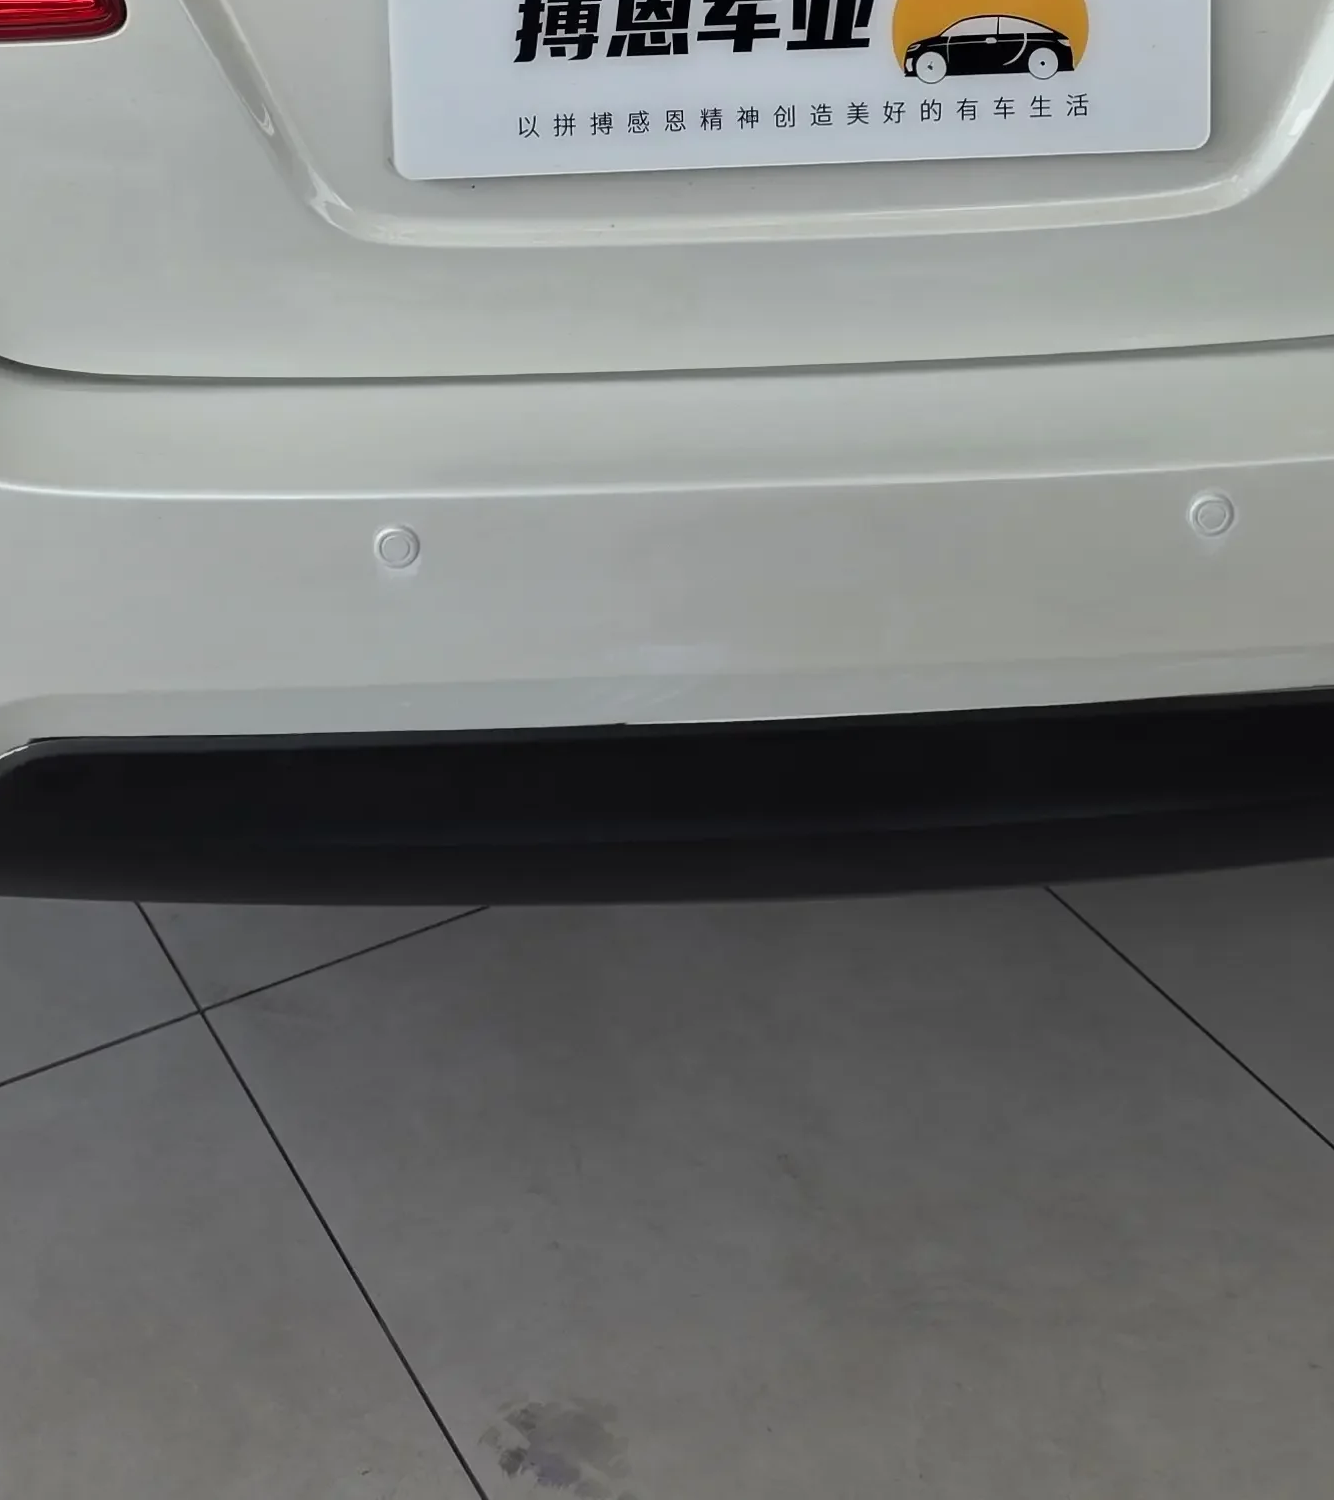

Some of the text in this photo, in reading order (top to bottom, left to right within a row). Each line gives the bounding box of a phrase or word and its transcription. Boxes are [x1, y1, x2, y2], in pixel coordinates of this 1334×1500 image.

[518, 93, 1089, 138] 以拼搏感恩精神创造美好的有车生活
